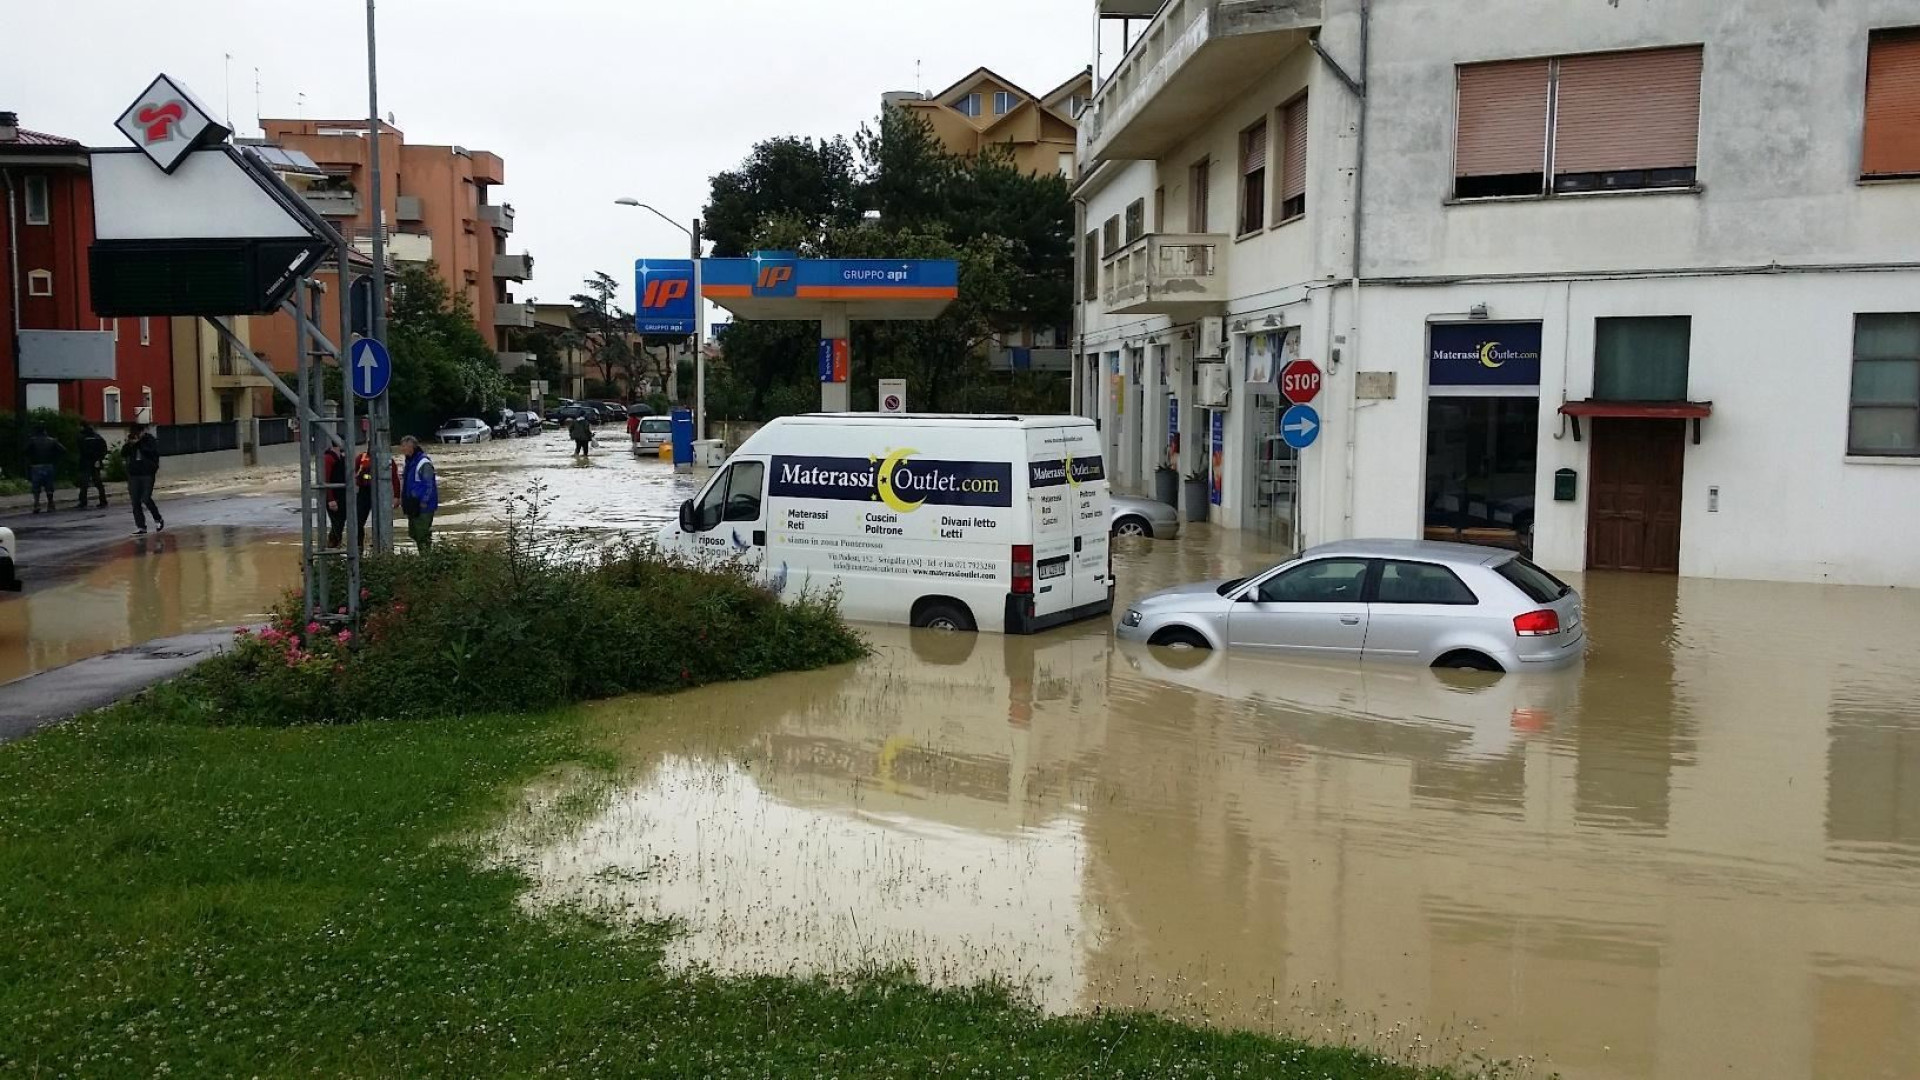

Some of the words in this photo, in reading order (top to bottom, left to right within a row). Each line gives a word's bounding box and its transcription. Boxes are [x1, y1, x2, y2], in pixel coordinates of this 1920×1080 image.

[756, 266, 792, 288] IP
[843, 269, 885, 281] GRUPPO
[887, 269, 907, 282] api
[642, 280, 688, 308] IP
[645, 323, 669, 331] GRUPPO
[670, 322, 682, 332] api
[1432, 350, 1480, 360] Materassi
[1488, 350, 1538, 360] Outlet.com
[1285, 372, 1320, 391] STOP
[780, 463, 875, 488] Materassi
[894, 467, 999, 493] Outlet.com
[1033, 465, 1066, 481] Materassi
[788, 509, 829, 520] Materassi
[865, 512, 898, 523] Cuscini
[787, 520, 805, 531] Reti
[941, 516, 971, 527] Divani
[973, 517, 996, 528] letto
[865, 524, 903, 536] Poltrone
[940, 528, 963, 539] Letti
[698, 536, 726, 547] riposo
[788, 536, 809, 546] siamo
[811, 537, 819, 546] in
[912, 568, 996, 580] www.materassioutlet.com
